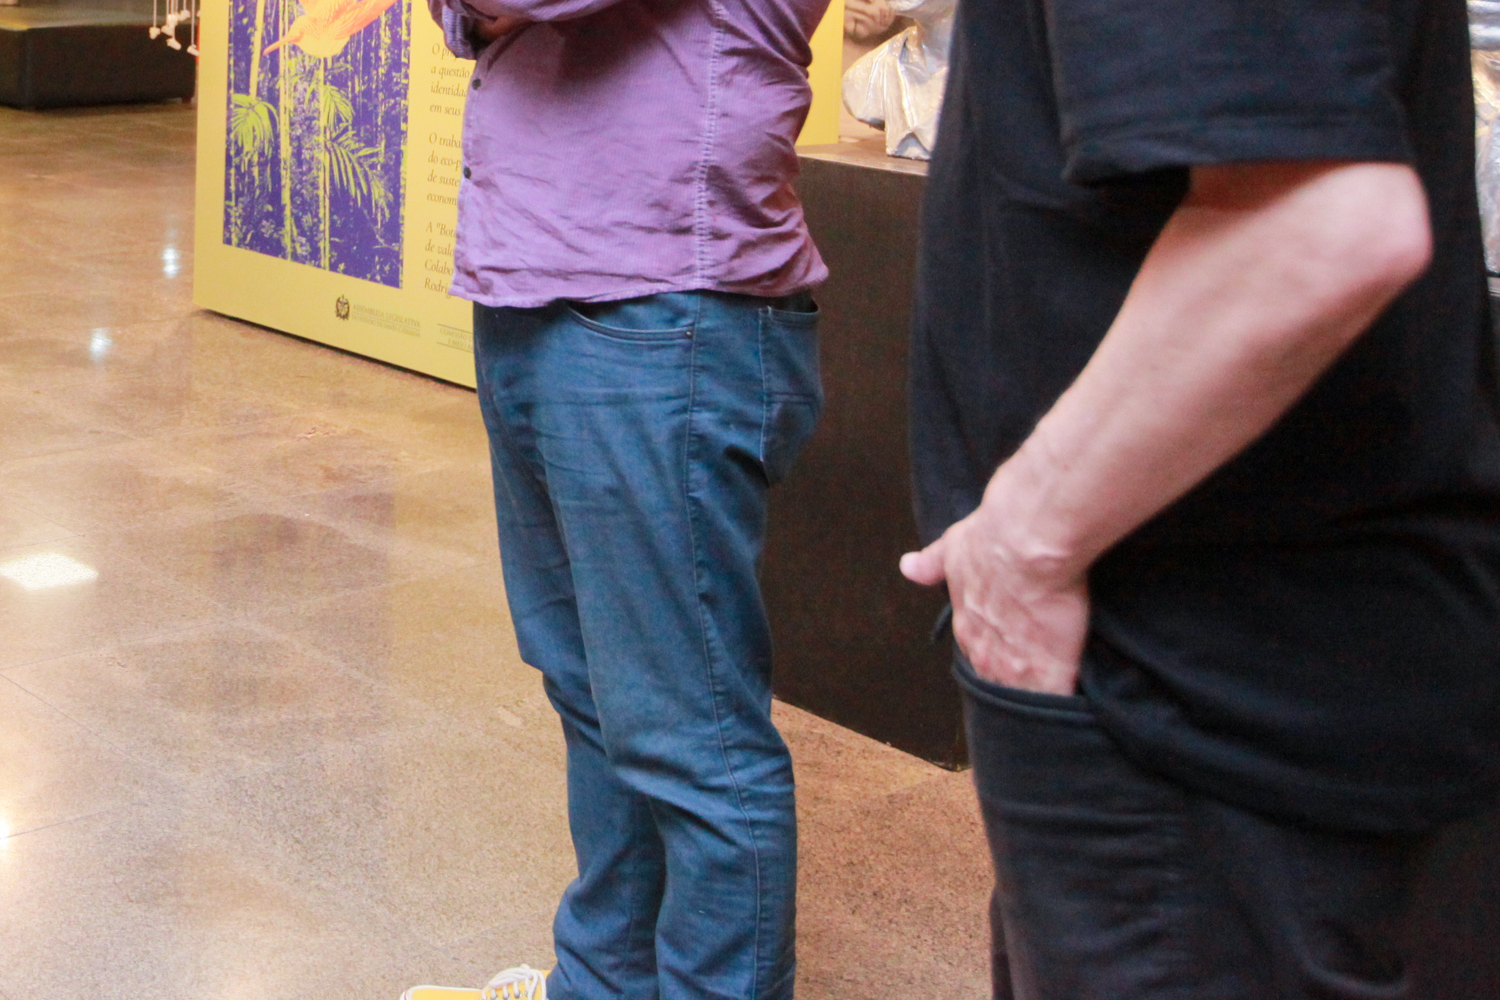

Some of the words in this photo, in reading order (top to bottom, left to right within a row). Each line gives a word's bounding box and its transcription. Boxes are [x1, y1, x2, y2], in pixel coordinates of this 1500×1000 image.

[431, 43, 440, 55] O
[430, 66, 437, 74] a
[438, 66, 470, 79] questão
[429, 104, 442, 113] em
[444, 105, 461, 116] seus
[428, 132, 438, 144] O
[427, 150, 439, 164] do
[427, 169, 438, 183] de
[425, 221, 433, 233] A
[424, 238, 435, 253] de
[424, 259, 454, 276] Colabo
